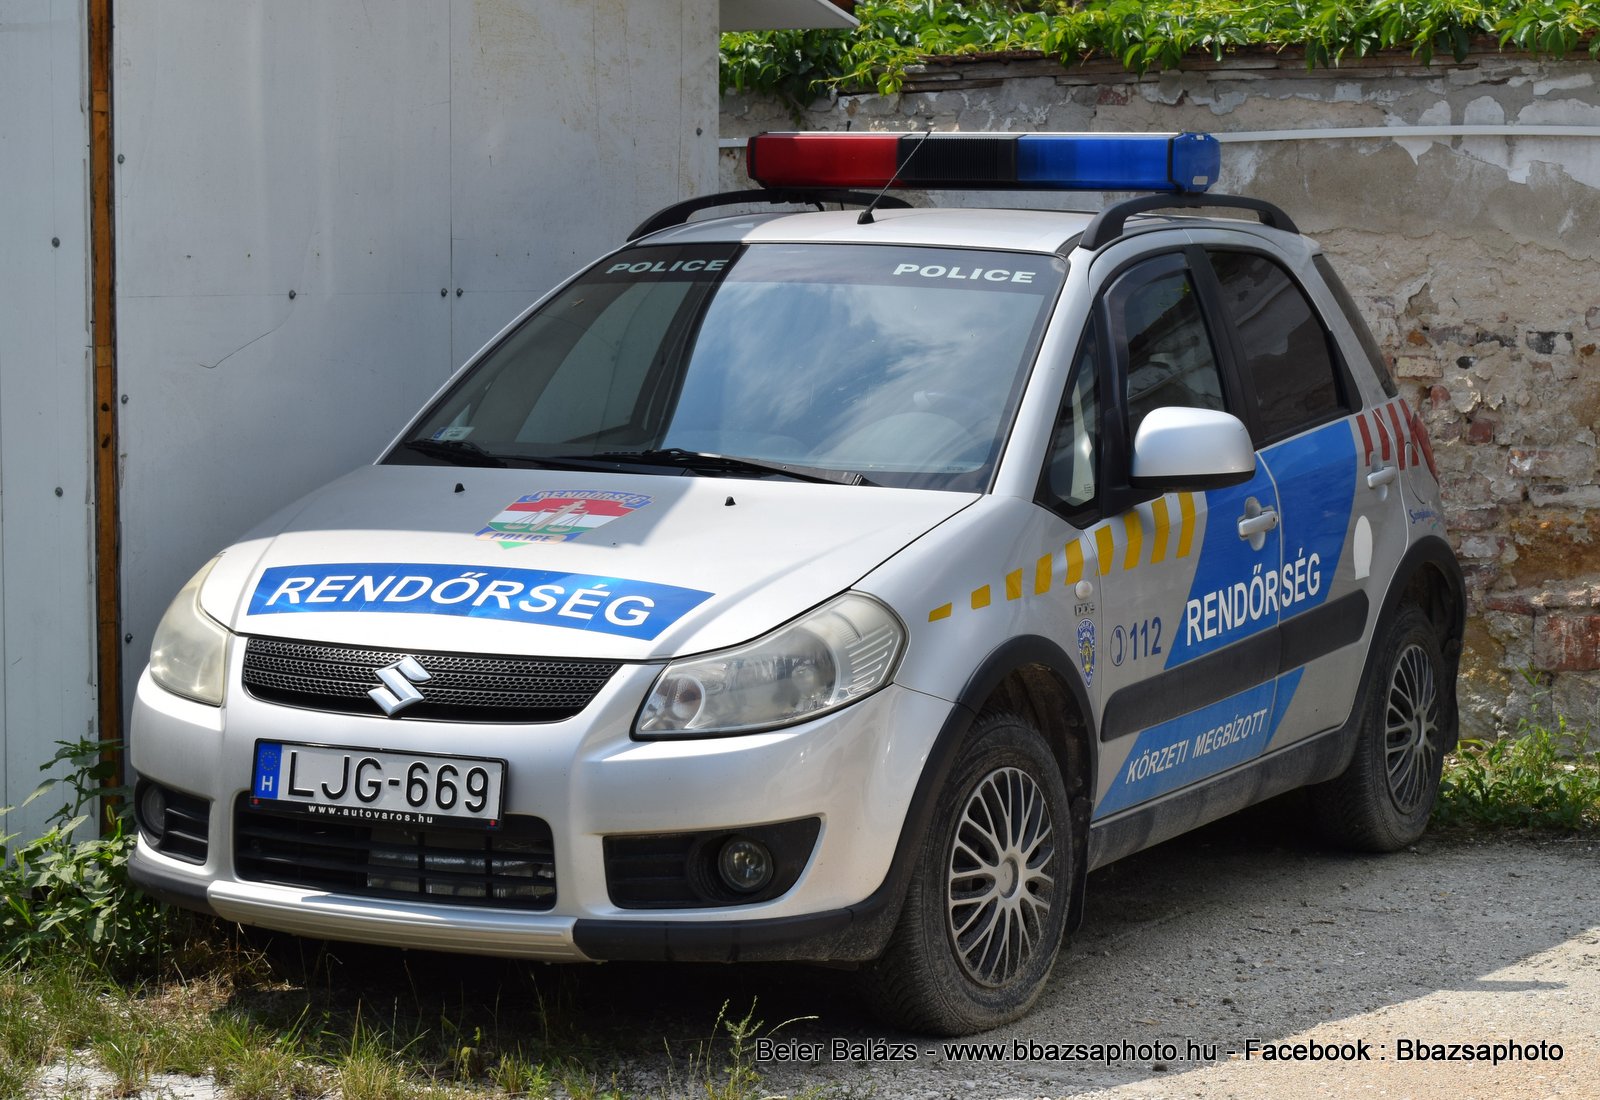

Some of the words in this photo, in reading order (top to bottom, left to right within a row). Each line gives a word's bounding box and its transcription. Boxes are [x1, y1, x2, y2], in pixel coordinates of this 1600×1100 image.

[605, 259, 730, 275] POLICE
[893, 263, 1036, 284] POLICE
[490, 532, 556, 542] POLICE
[265, 571, 657, 627] RENDŐRSÉG
[1186, 548, 1321, 646] RENDŐRSÉG
[1129, 616, 1162, 660] 112
[1125, 739, 1190, 784] KÖRZETI
[1192, 709, 1268, 759] MEGBÍZOTT
[261, 775, 273, 792] H
[288, 750, 489, 813] LJG-669
[308, 804, 434, 824] www.autovaros.hu
